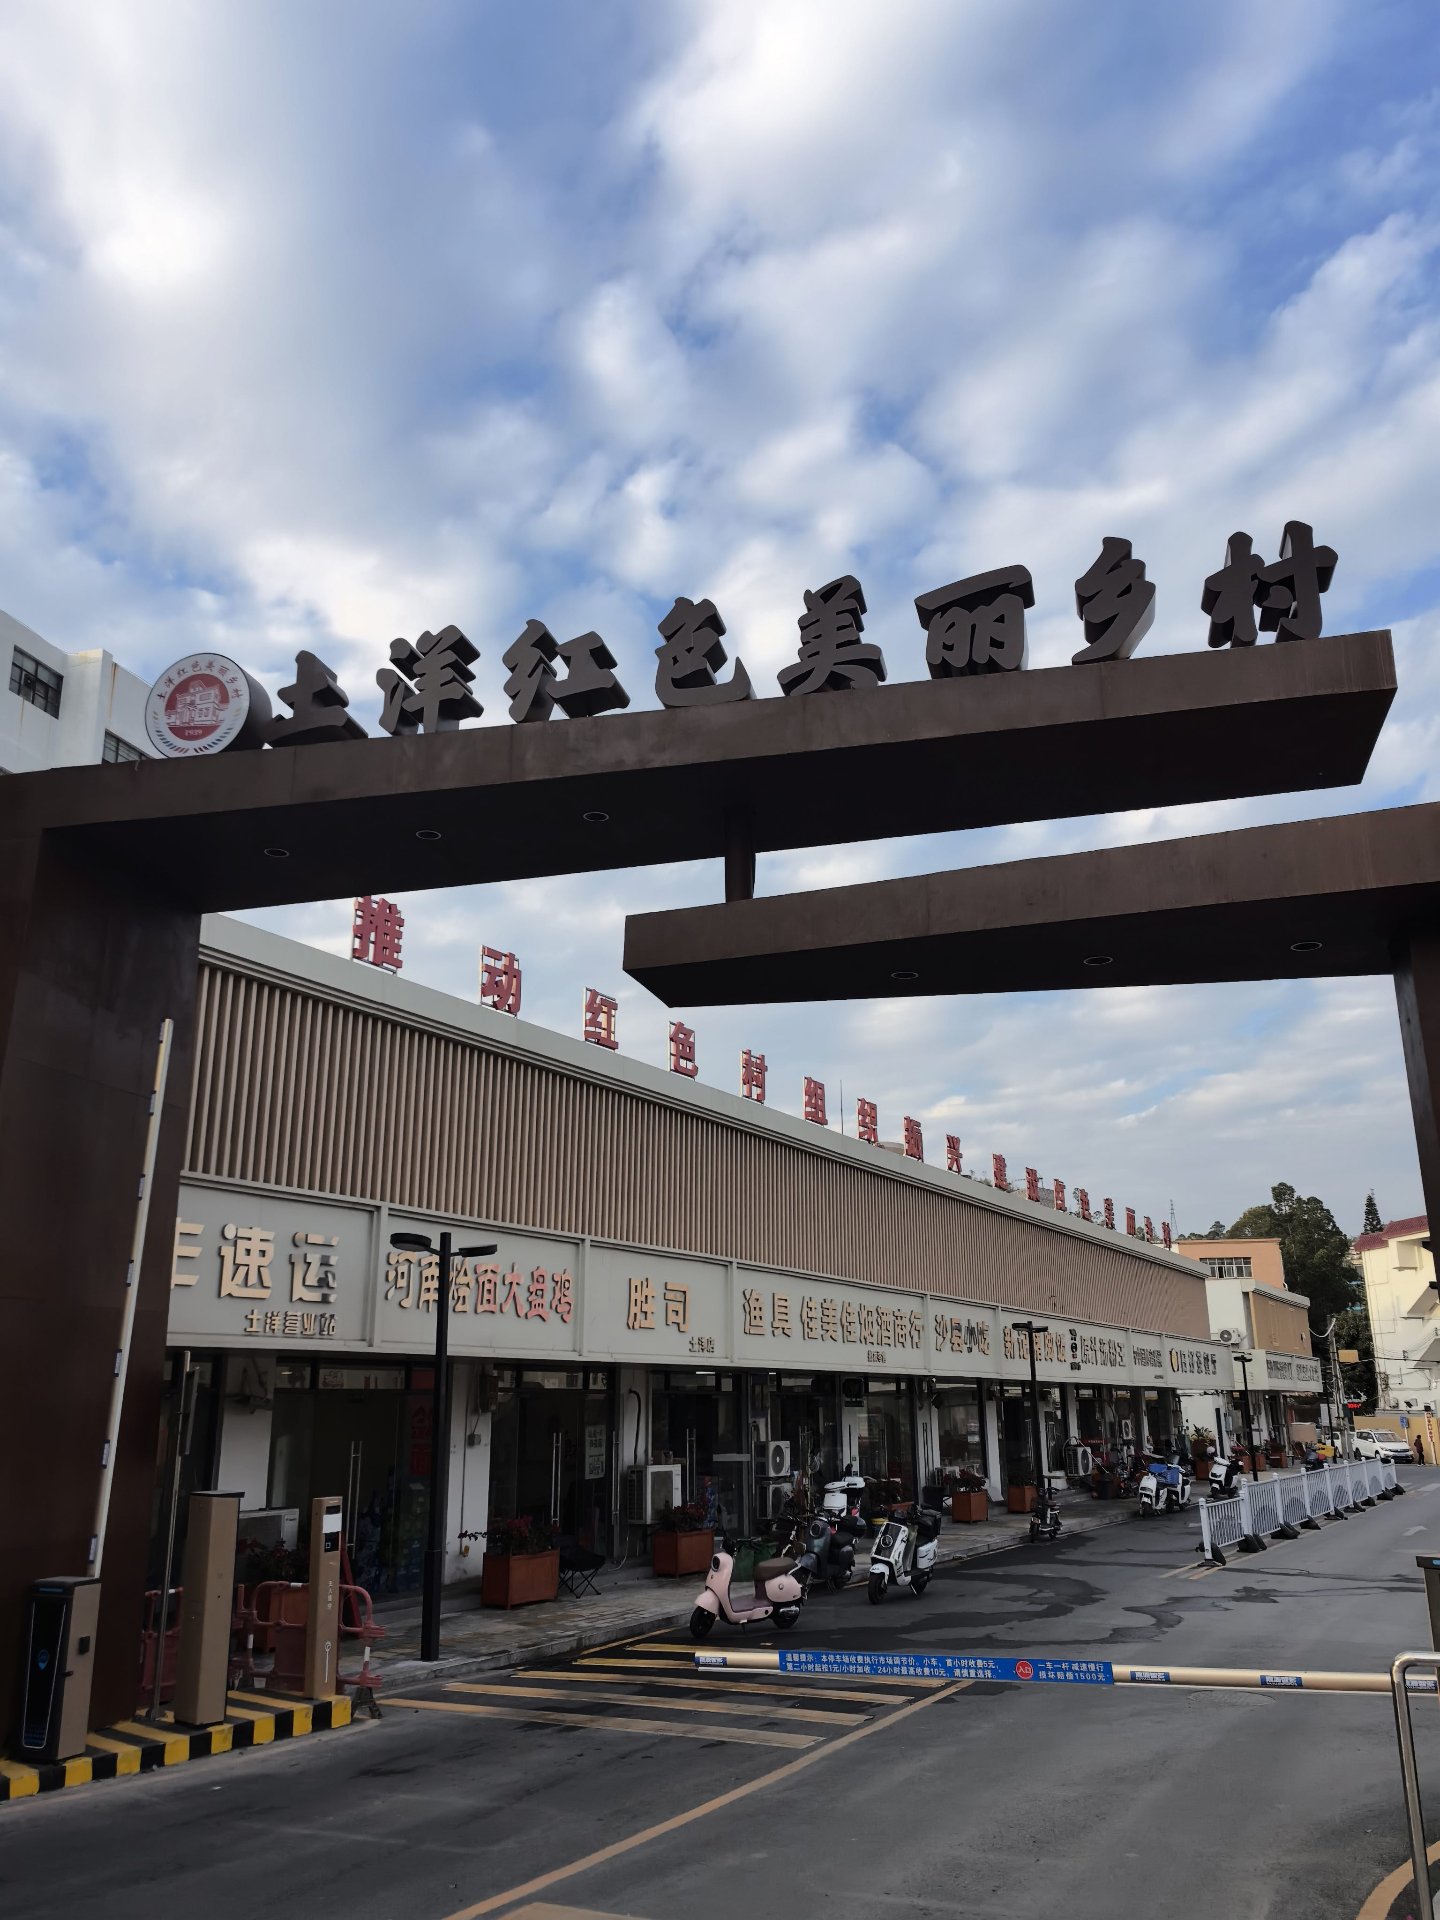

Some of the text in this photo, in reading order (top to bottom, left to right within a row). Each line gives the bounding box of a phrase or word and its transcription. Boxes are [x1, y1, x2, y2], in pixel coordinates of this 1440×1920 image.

[264, 521, 1338, 747] 土洋红色美丽乡村
[934, 1314, 990, 1356] 沙县小吃
